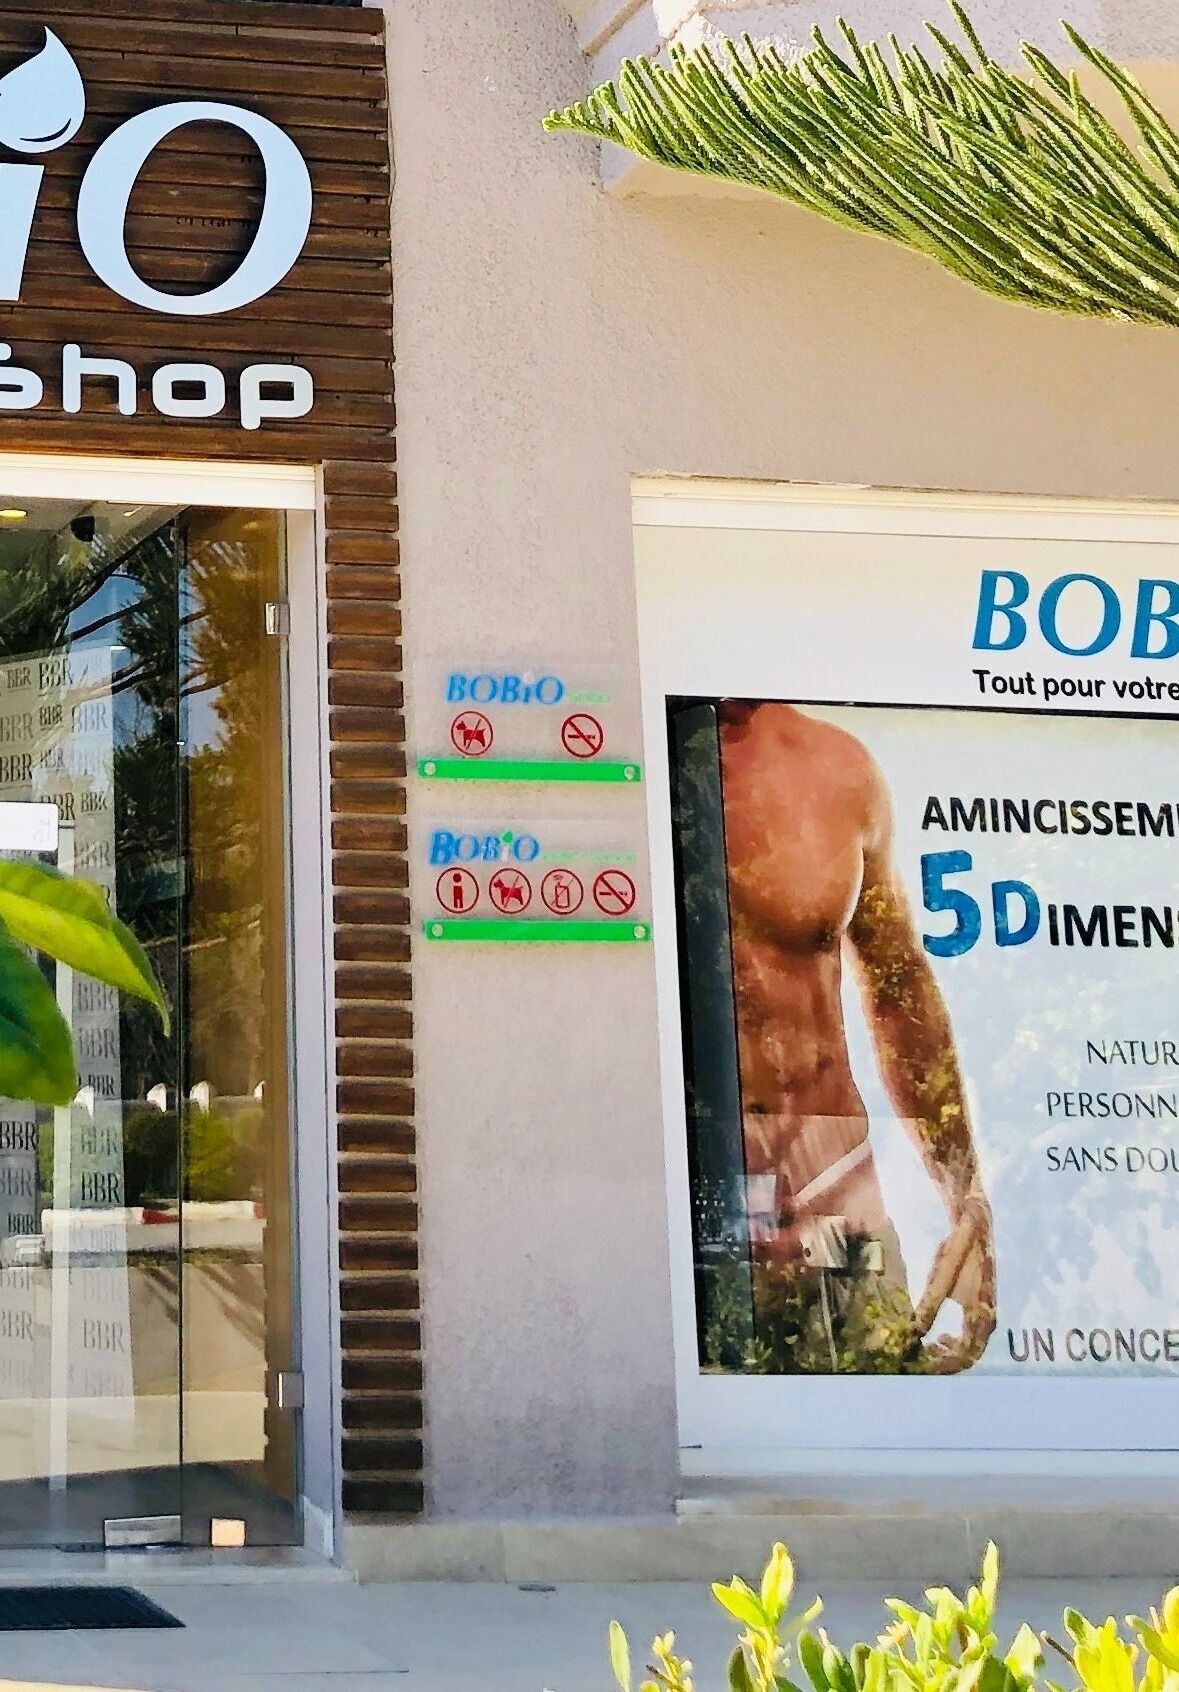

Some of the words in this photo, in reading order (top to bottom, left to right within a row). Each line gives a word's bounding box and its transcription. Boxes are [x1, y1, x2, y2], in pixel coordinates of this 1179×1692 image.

[972, 569, 1179, 659] BOB
[972, 669, 1036, 695] Tout
[1044, 676, 1106, 701] pour
[1113, 676, 1179, 700] votre
[921, 796, 1179, 837] AMINCISSEM
[991, 880, 1179, 948] DIMEN
[1086, 1040, 1179, 1066] NATUR
[1046, 1092, 1178, 1118] PERSONN
[0, 1120, 37, 1150] BBR
[1046, 1146, 1119, 1172] SANS
[81, 1171, 120, 1203] BBR
[83, 1318, 125, 1353] BBR
[1006, 1328, 1054, 1362] UN
[1065, 1328, 1179, 1362] CONCE
